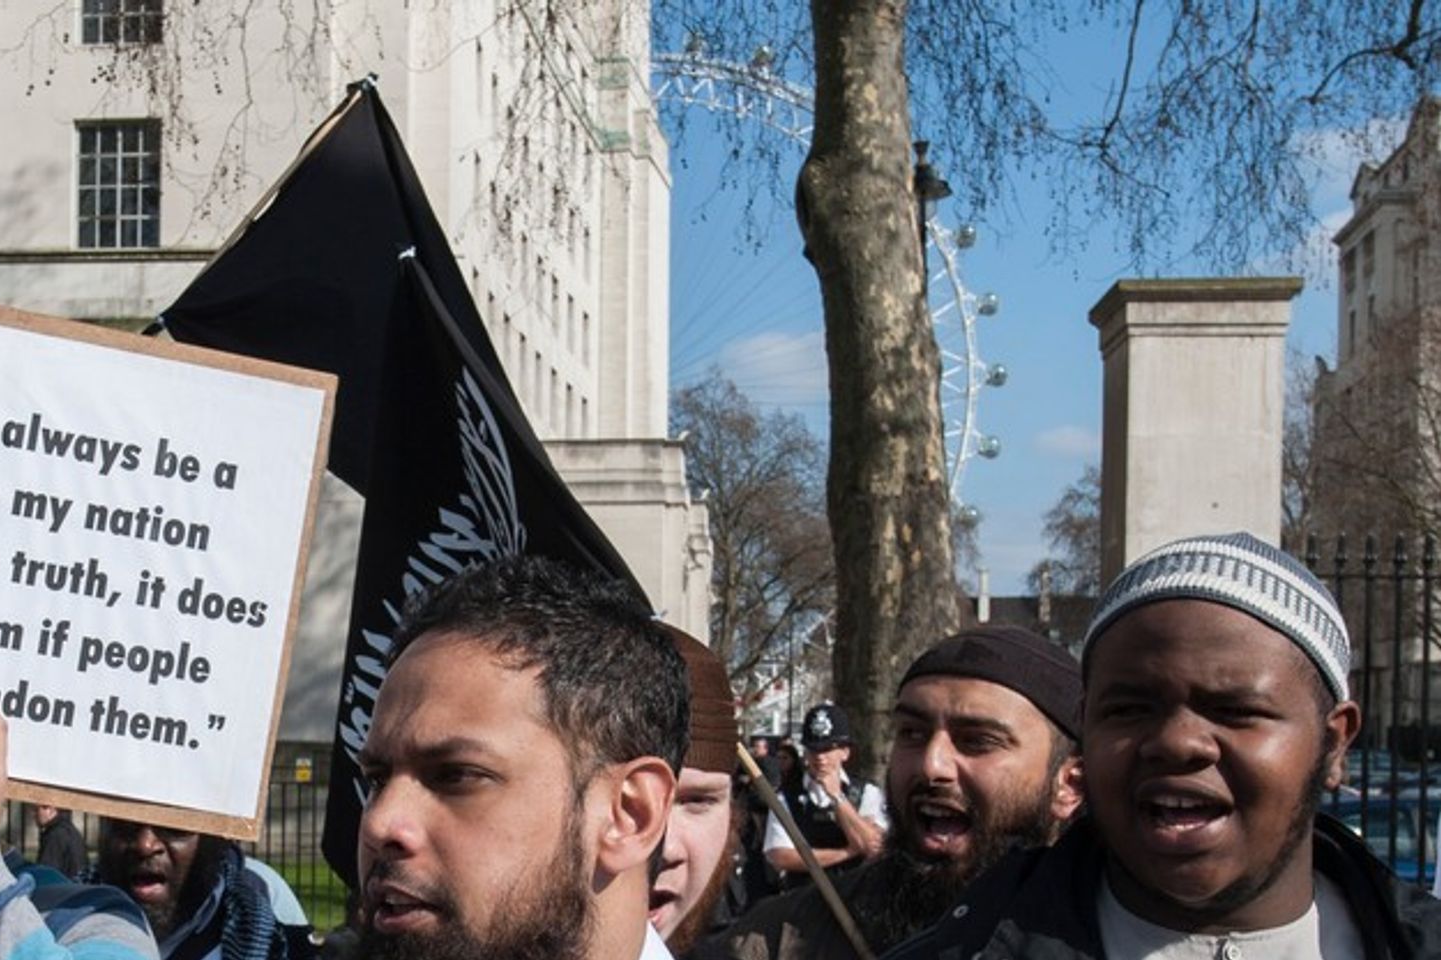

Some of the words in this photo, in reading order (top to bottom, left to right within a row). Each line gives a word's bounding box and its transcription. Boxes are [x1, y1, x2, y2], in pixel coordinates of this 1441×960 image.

[2, 412, 142, 476] always
[154, 438, 200, 483] be
[213, 461, 238, 490] a
[12, 490, 73, 533] my
[85, 503, 210, 551] nation
[11, 550, 122, 608] truth,
[137, 569, 166, 609] it
[178, 577, 268, 628] does
[38, 618, 71, 658] if
[77, 636, 211, 686] people
[90, 695, 226, 750] them.”
